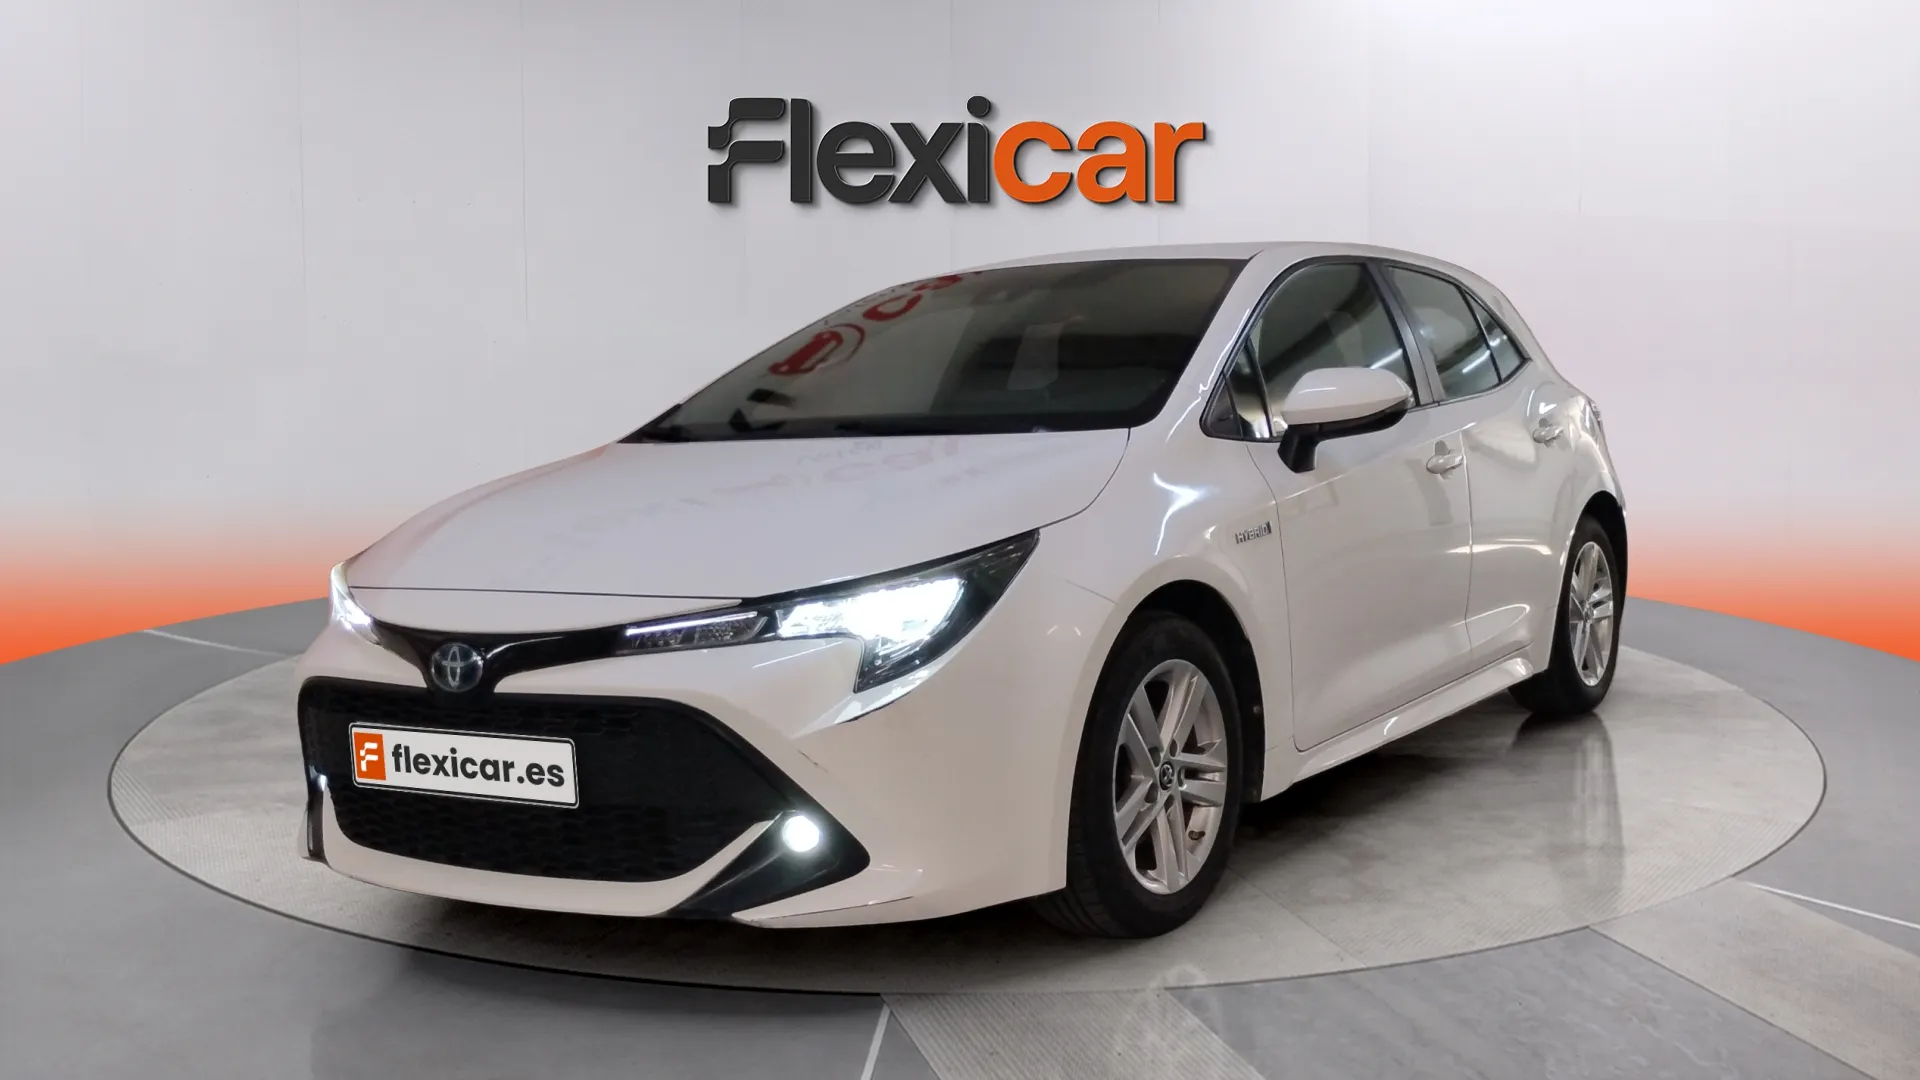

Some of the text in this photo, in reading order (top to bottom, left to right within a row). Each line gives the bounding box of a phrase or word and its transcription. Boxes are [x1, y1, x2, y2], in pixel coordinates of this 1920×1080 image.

[707, 95, 1206, 204] Flexicar
[1234, 521, 1271, 545] HYBRID
[391, 743, 566, 788] flexicar.es
